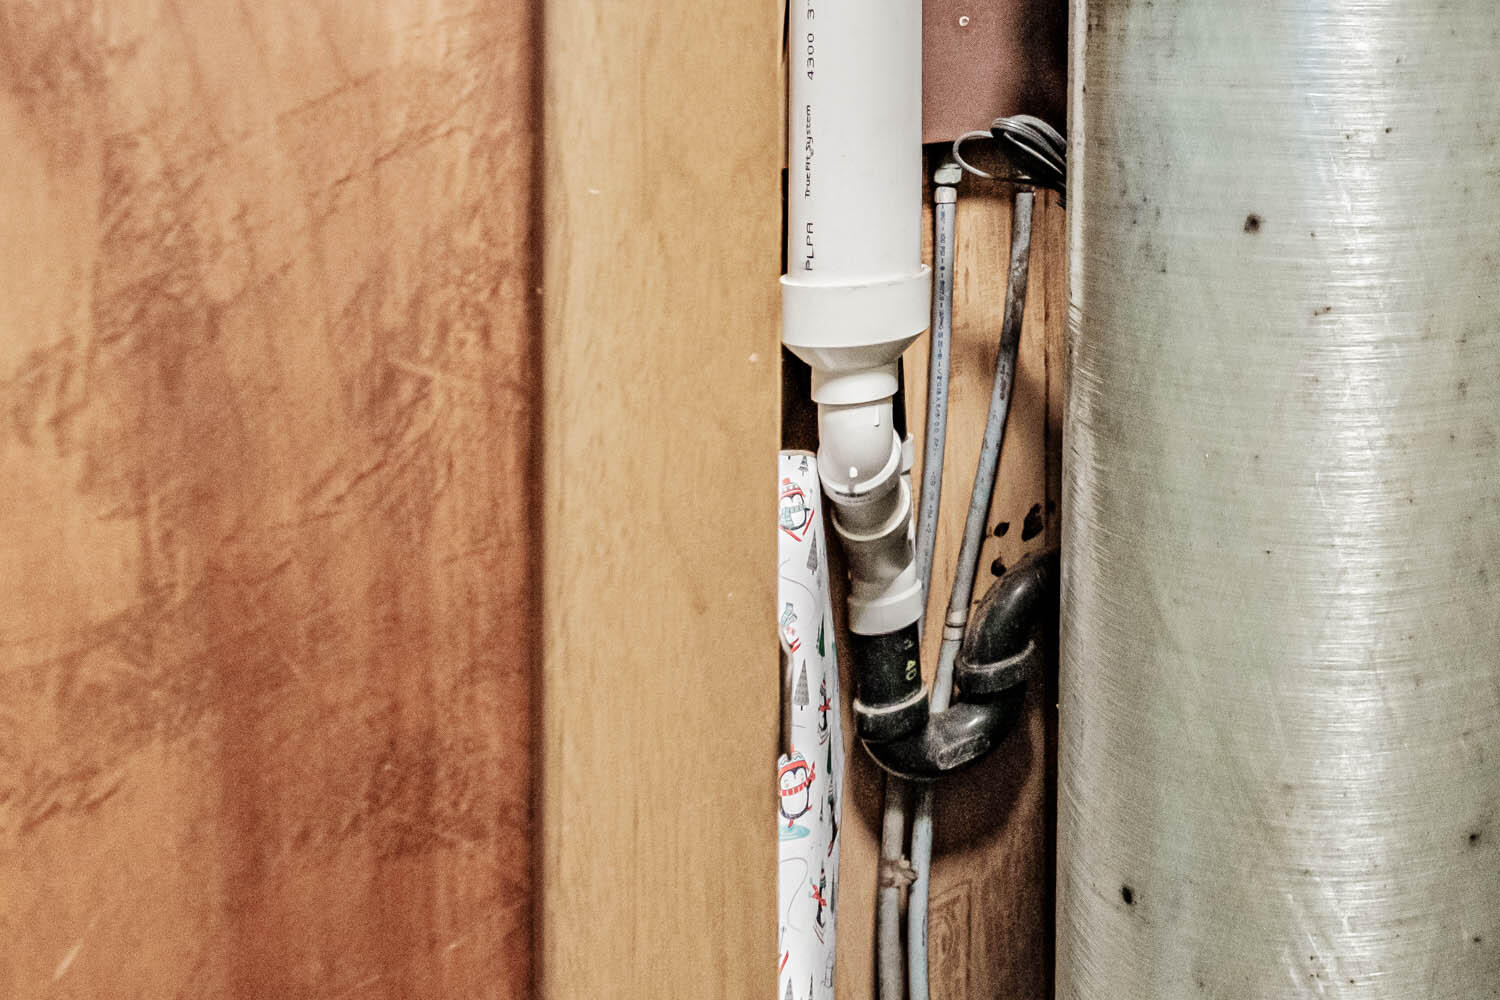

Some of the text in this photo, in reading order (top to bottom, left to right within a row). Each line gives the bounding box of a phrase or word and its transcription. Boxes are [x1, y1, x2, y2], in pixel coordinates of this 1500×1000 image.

[807, 33, 815, 80] 4300
[805, 222, 814, 271] PLPA
[905, 660, 916, 680] 40
